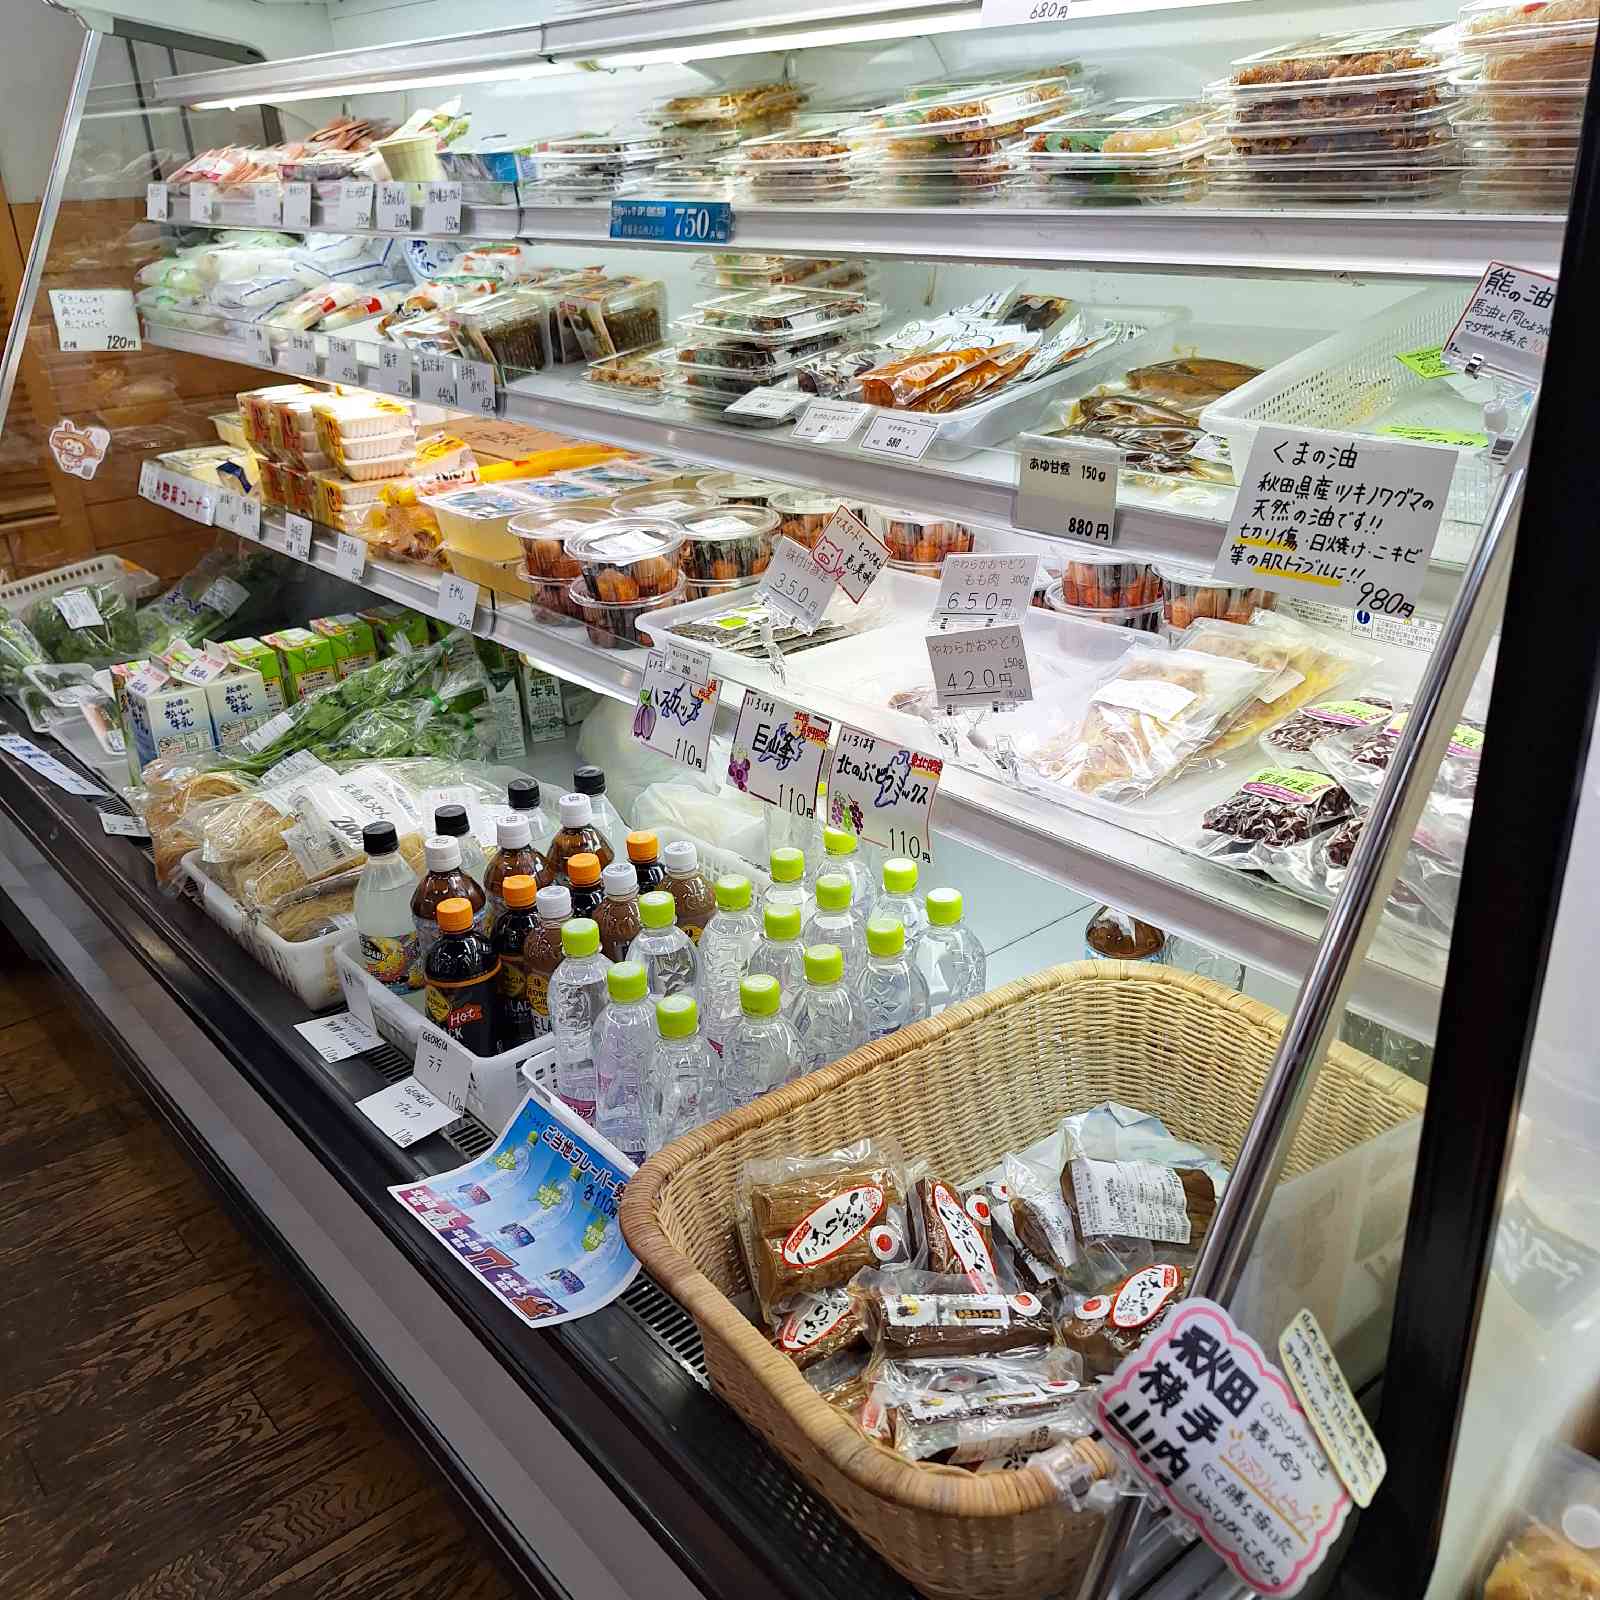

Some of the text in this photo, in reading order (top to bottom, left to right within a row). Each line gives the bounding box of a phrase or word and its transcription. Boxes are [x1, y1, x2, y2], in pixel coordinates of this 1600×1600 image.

[1029, 2, 1068, 19] 680円
[675, 209, 710, 238] 750
[1485, 268, 1554, 309] 熊の油
[107, 335, 136, 350] 120円
[1273, 441, 1357, 469] くまの油
[1029, 458, 1106, 482] あゆ甘煮 150g
[1068, 517, 1109, 541] 880円
[947, 592, 1013, 610] 650円
[1356, 582, 1415, 617] 980円
[932, 635, 1020, 656] やわらかおやどり
[947, 668, 1013, 690] 420円
[675, 738, 702, 769] 110円
[779, 783, 814, 819] 110円
[889, 827, 931, 863] 110円
[450, 1008, 475, 1027] Hot
[422, 1031, 448, 1052] GEORGIA
[404, 1085, 435, 1109] GEORGIA
[1169, 1325, 1259, 1418] 秋田
[1138, 1360, 1224, 1445] 横手
[1105, 1402, 1191, 1488] 山内
